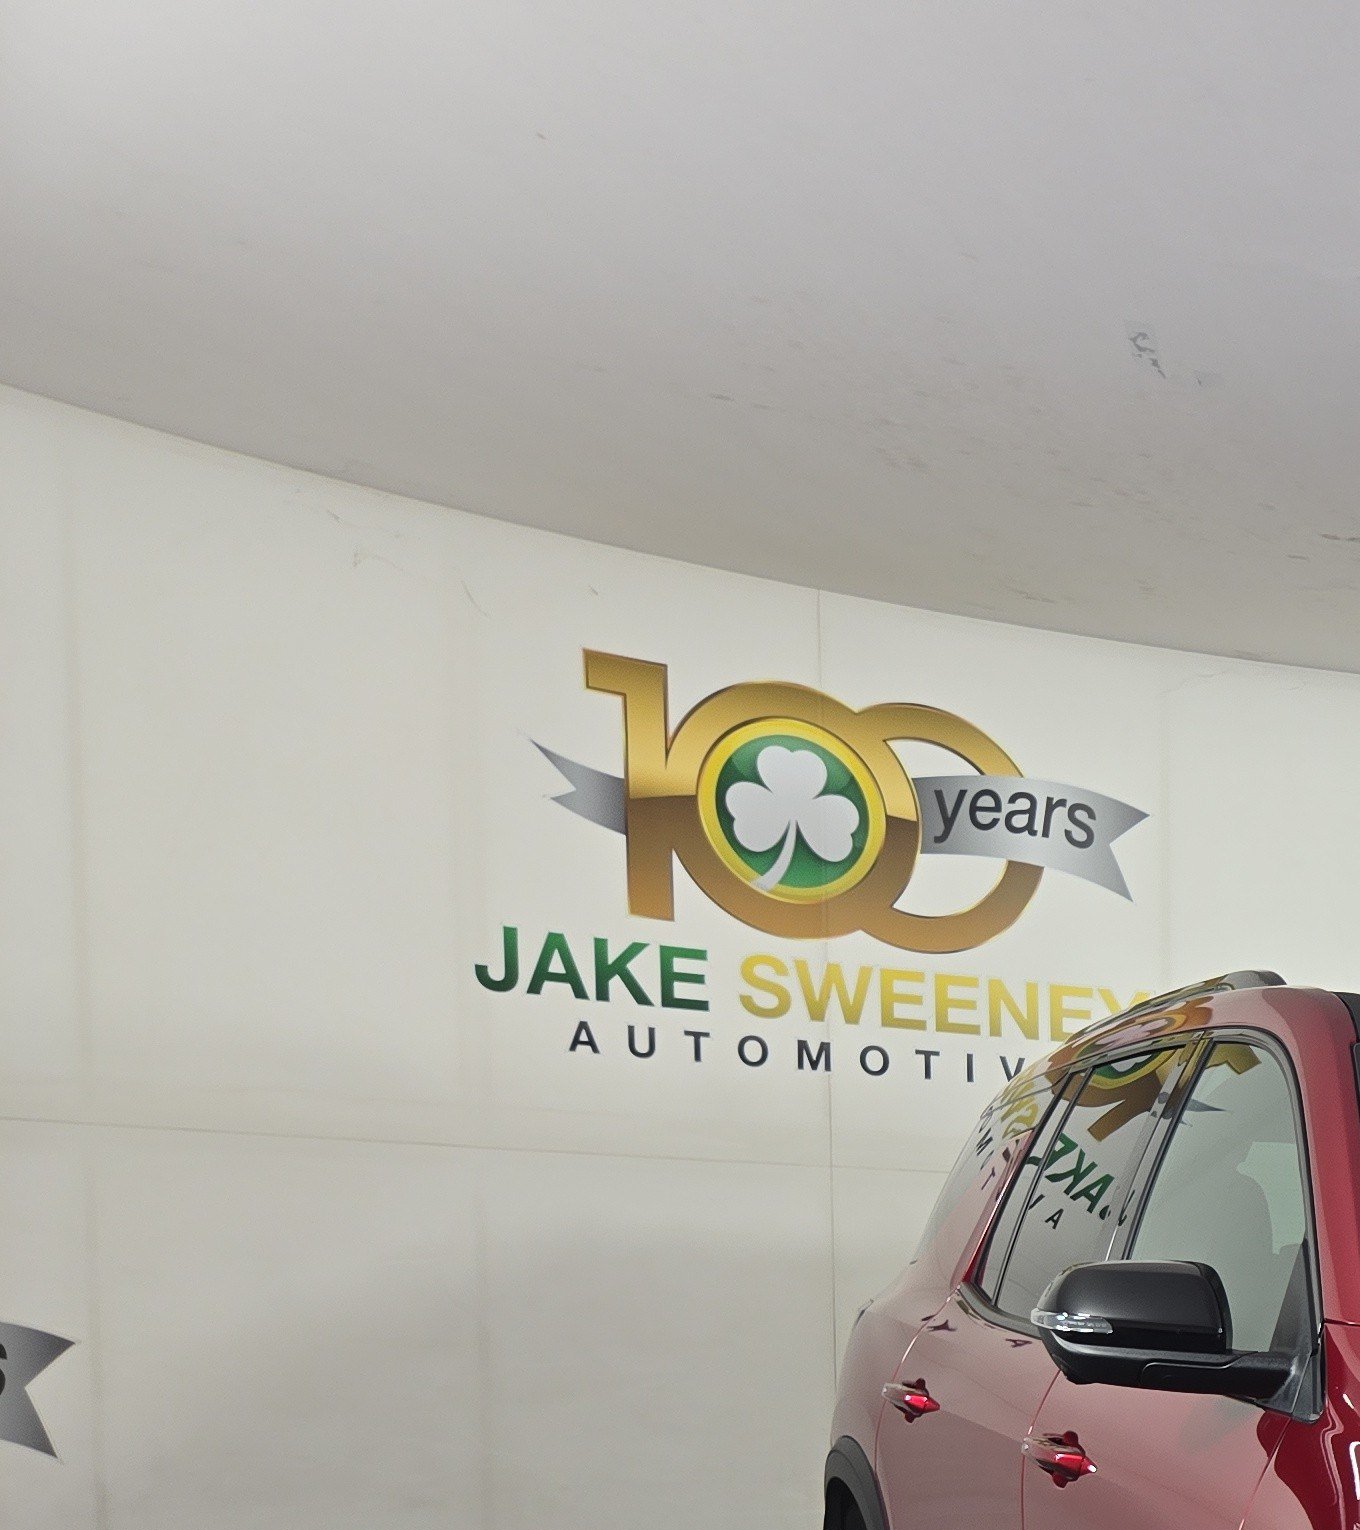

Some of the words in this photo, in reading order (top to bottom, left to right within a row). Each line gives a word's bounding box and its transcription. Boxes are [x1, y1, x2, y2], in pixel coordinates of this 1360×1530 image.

[582, 648, 1044, 954] 100
[932, 786, 1097, 850] years
[474, 925, 710, 1012] JAKE
[569, 1020, 1026, 1083] AUTOMOTIV
